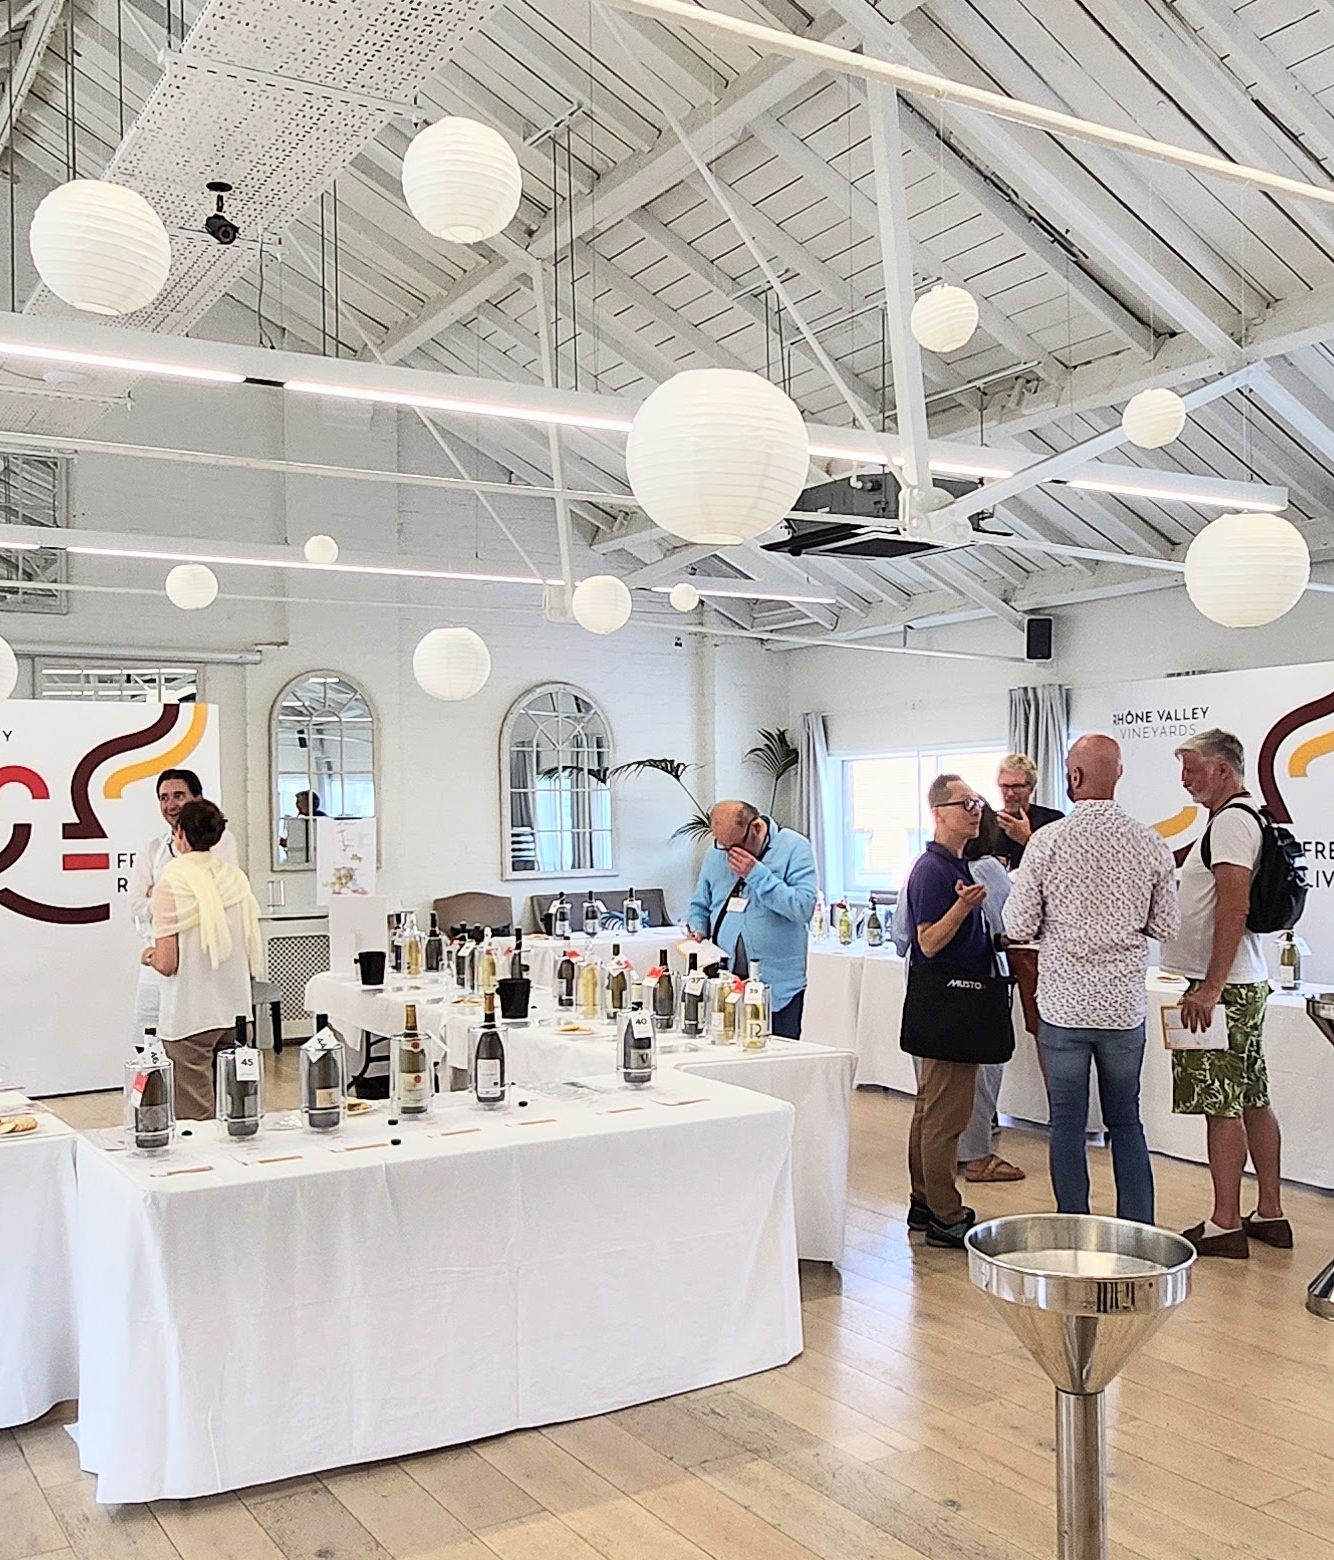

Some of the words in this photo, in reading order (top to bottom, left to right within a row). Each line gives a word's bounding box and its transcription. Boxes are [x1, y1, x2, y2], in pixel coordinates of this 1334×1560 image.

[1157, 706, 1209, 722] VALLEY
[1120, 723, 1196, 740] VINEYARDS
[946, 978, 983, 990] MUSTO
[240, 1058, 255, 1067] 45
